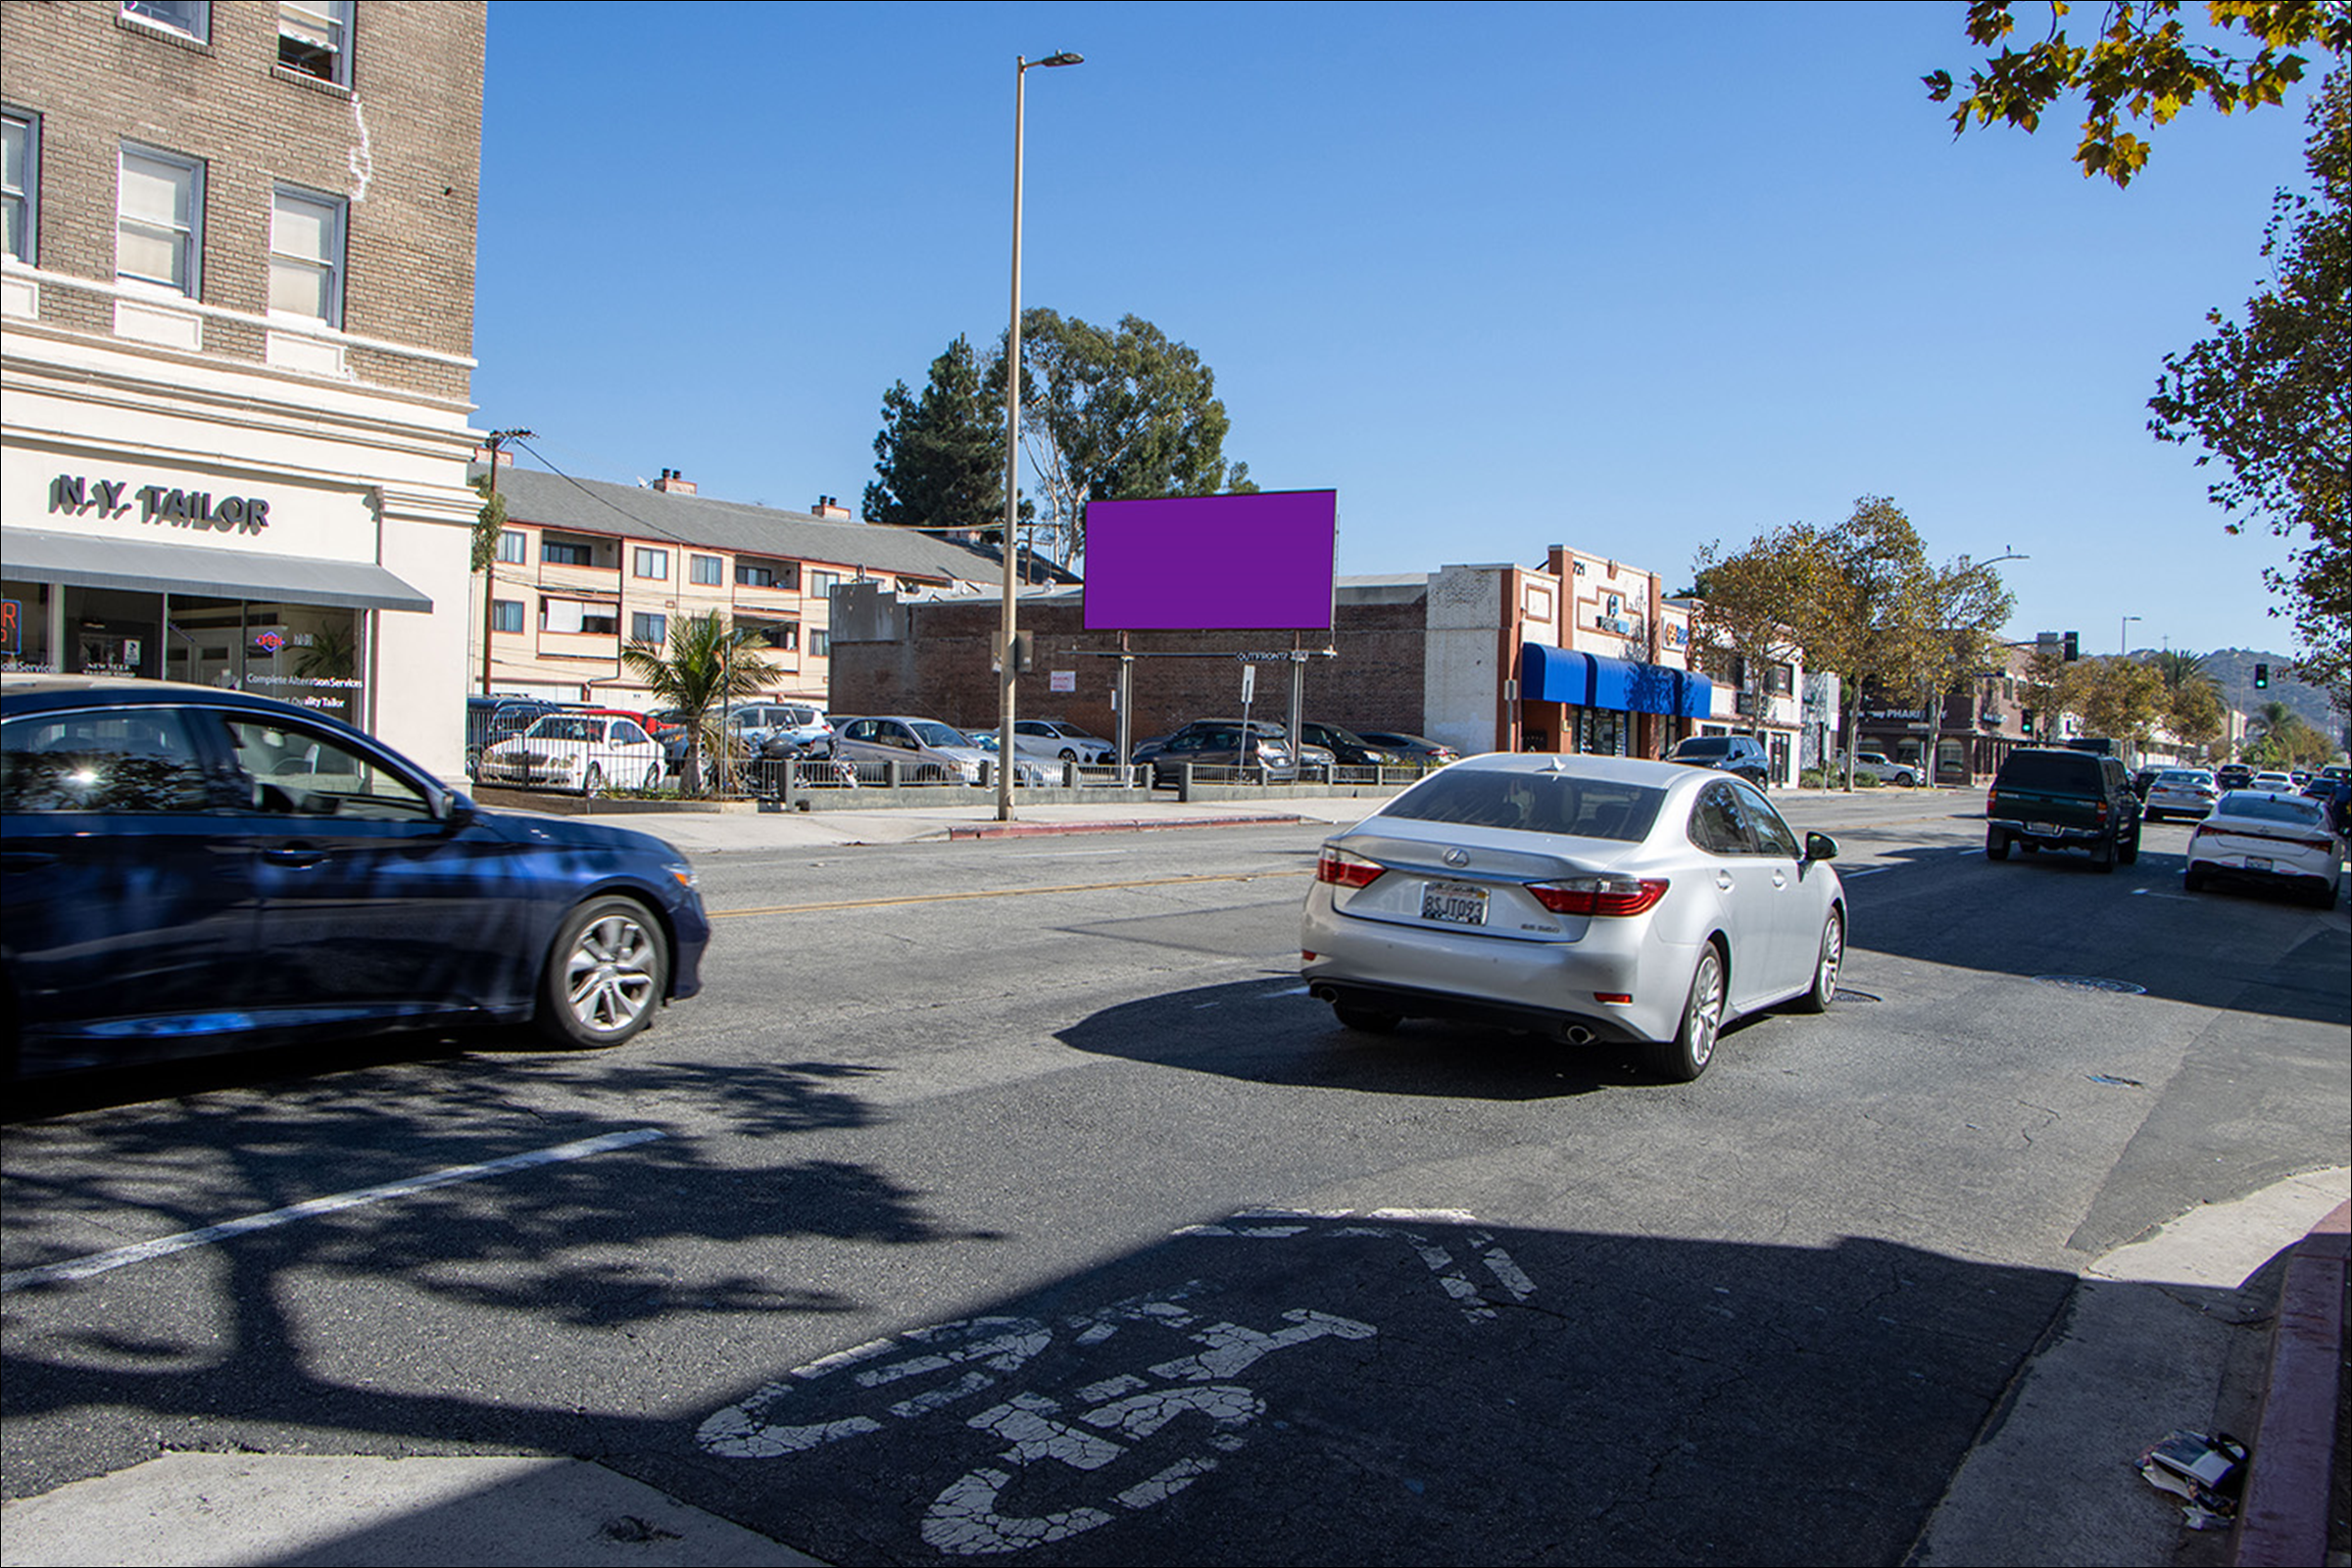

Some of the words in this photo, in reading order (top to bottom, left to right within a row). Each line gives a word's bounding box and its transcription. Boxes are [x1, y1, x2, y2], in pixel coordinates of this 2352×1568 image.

[56, 474, 132, 513] N.Y.
[142, 484, 270, 529] TAILOR
[246, 672, 287, 686] Complete
[288, 675, 330, 688] Alteration
[330, 676, 364, 689] Services
[321, 697, 345, 709] Tailor
[1425, 895, 1484, 918] 8SJT093
